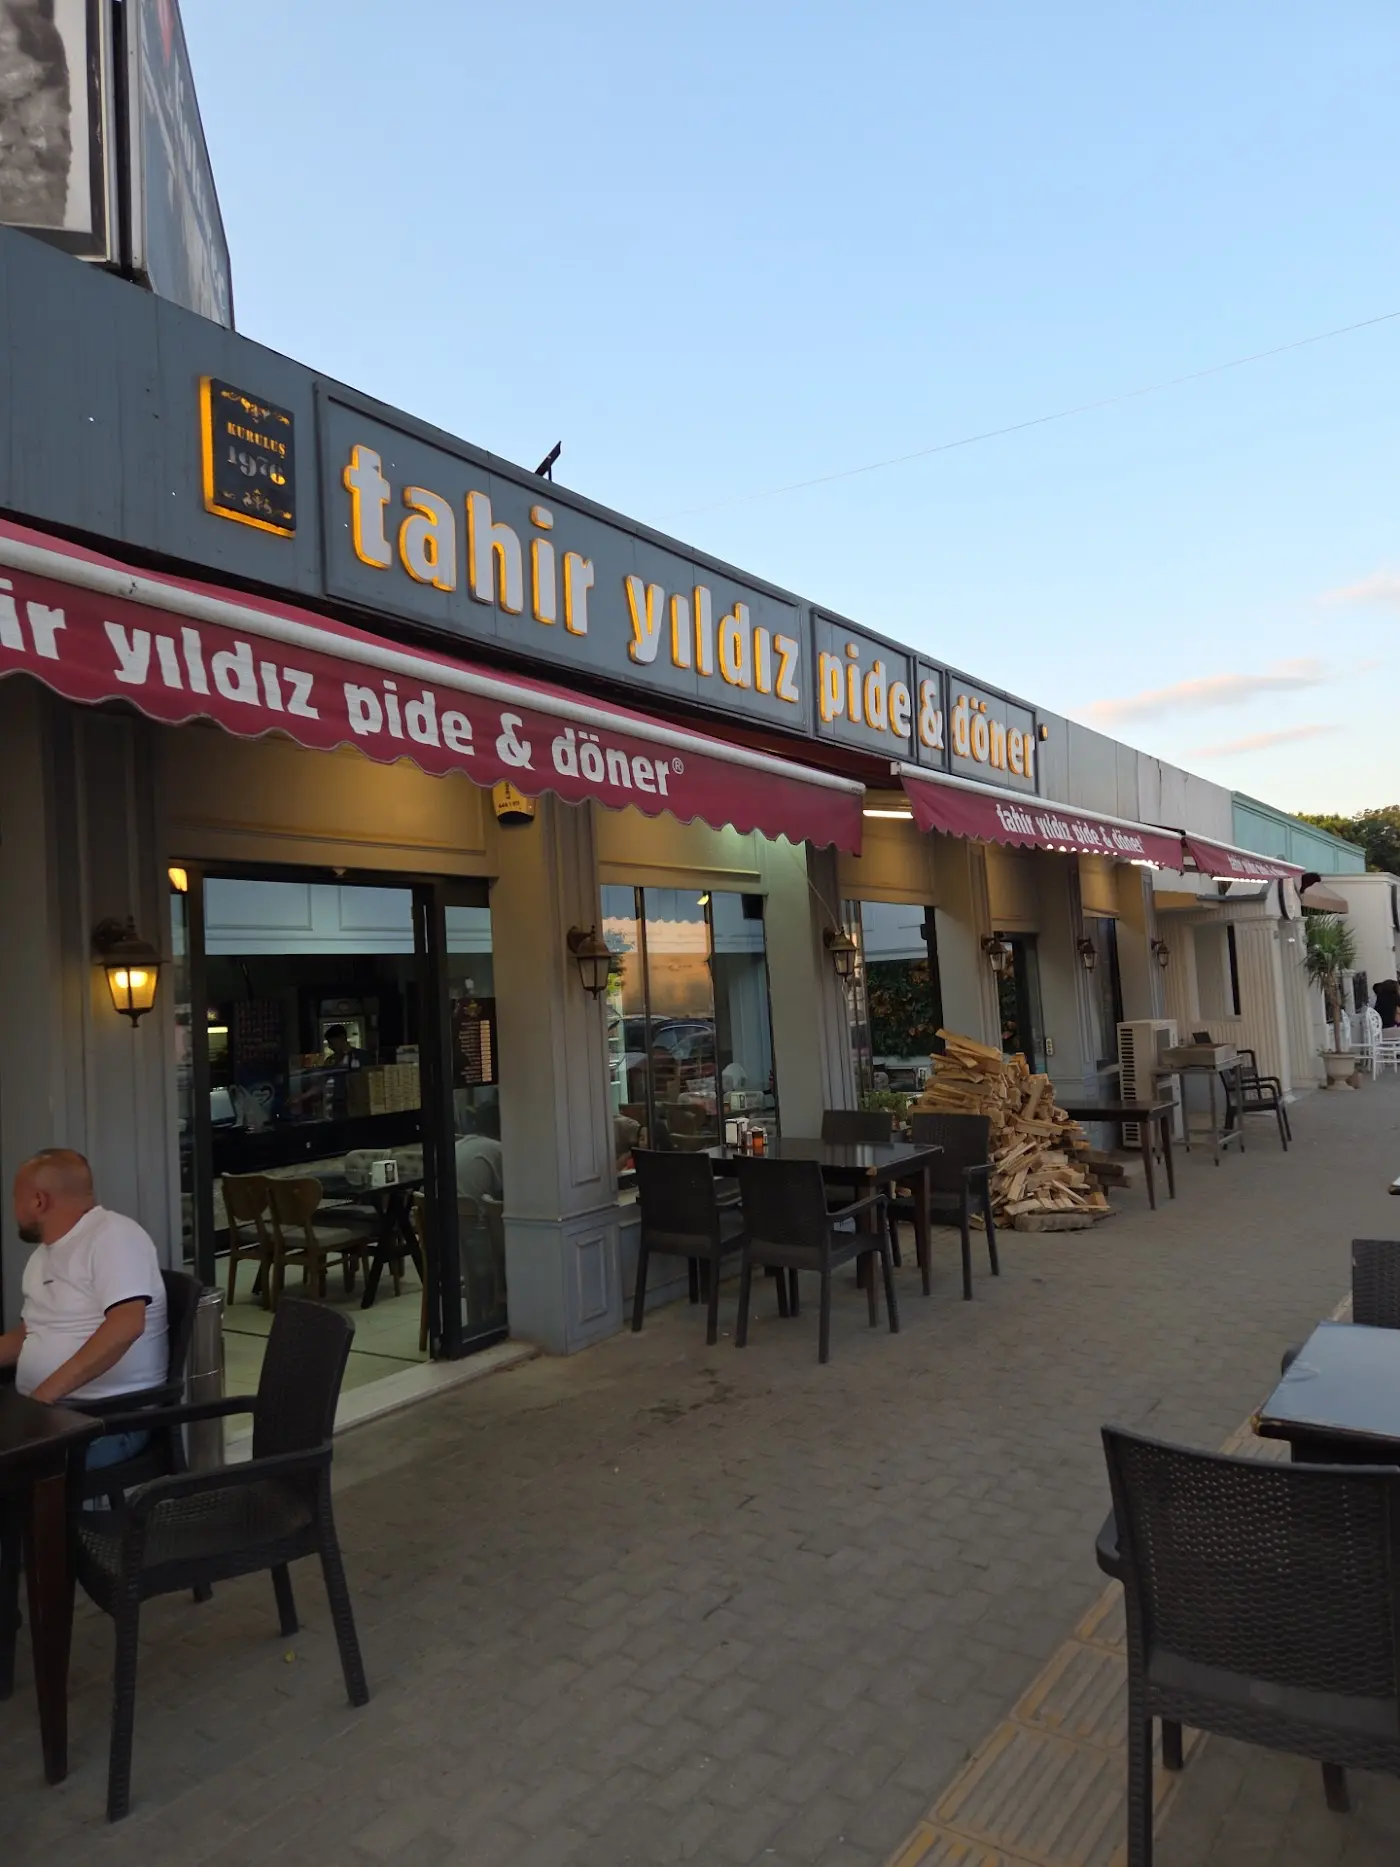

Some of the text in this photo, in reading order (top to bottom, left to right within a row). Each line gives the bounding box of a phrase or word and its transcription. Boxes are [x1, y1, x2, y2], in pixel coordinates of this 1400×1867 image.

[227, 421, 286, 458] KURULUŞ
[227, 445, 286, 486] 1976
[343, 444, 1035, 778] tahir yıldız pide & döner
[104, 620, 321, 720] yıldız
[343, 679, 475, 756] pide
[495, 712, 536, 771] &
[995, 803, 1036, 836] tahir
[1099, 825, 1116, 849] &
